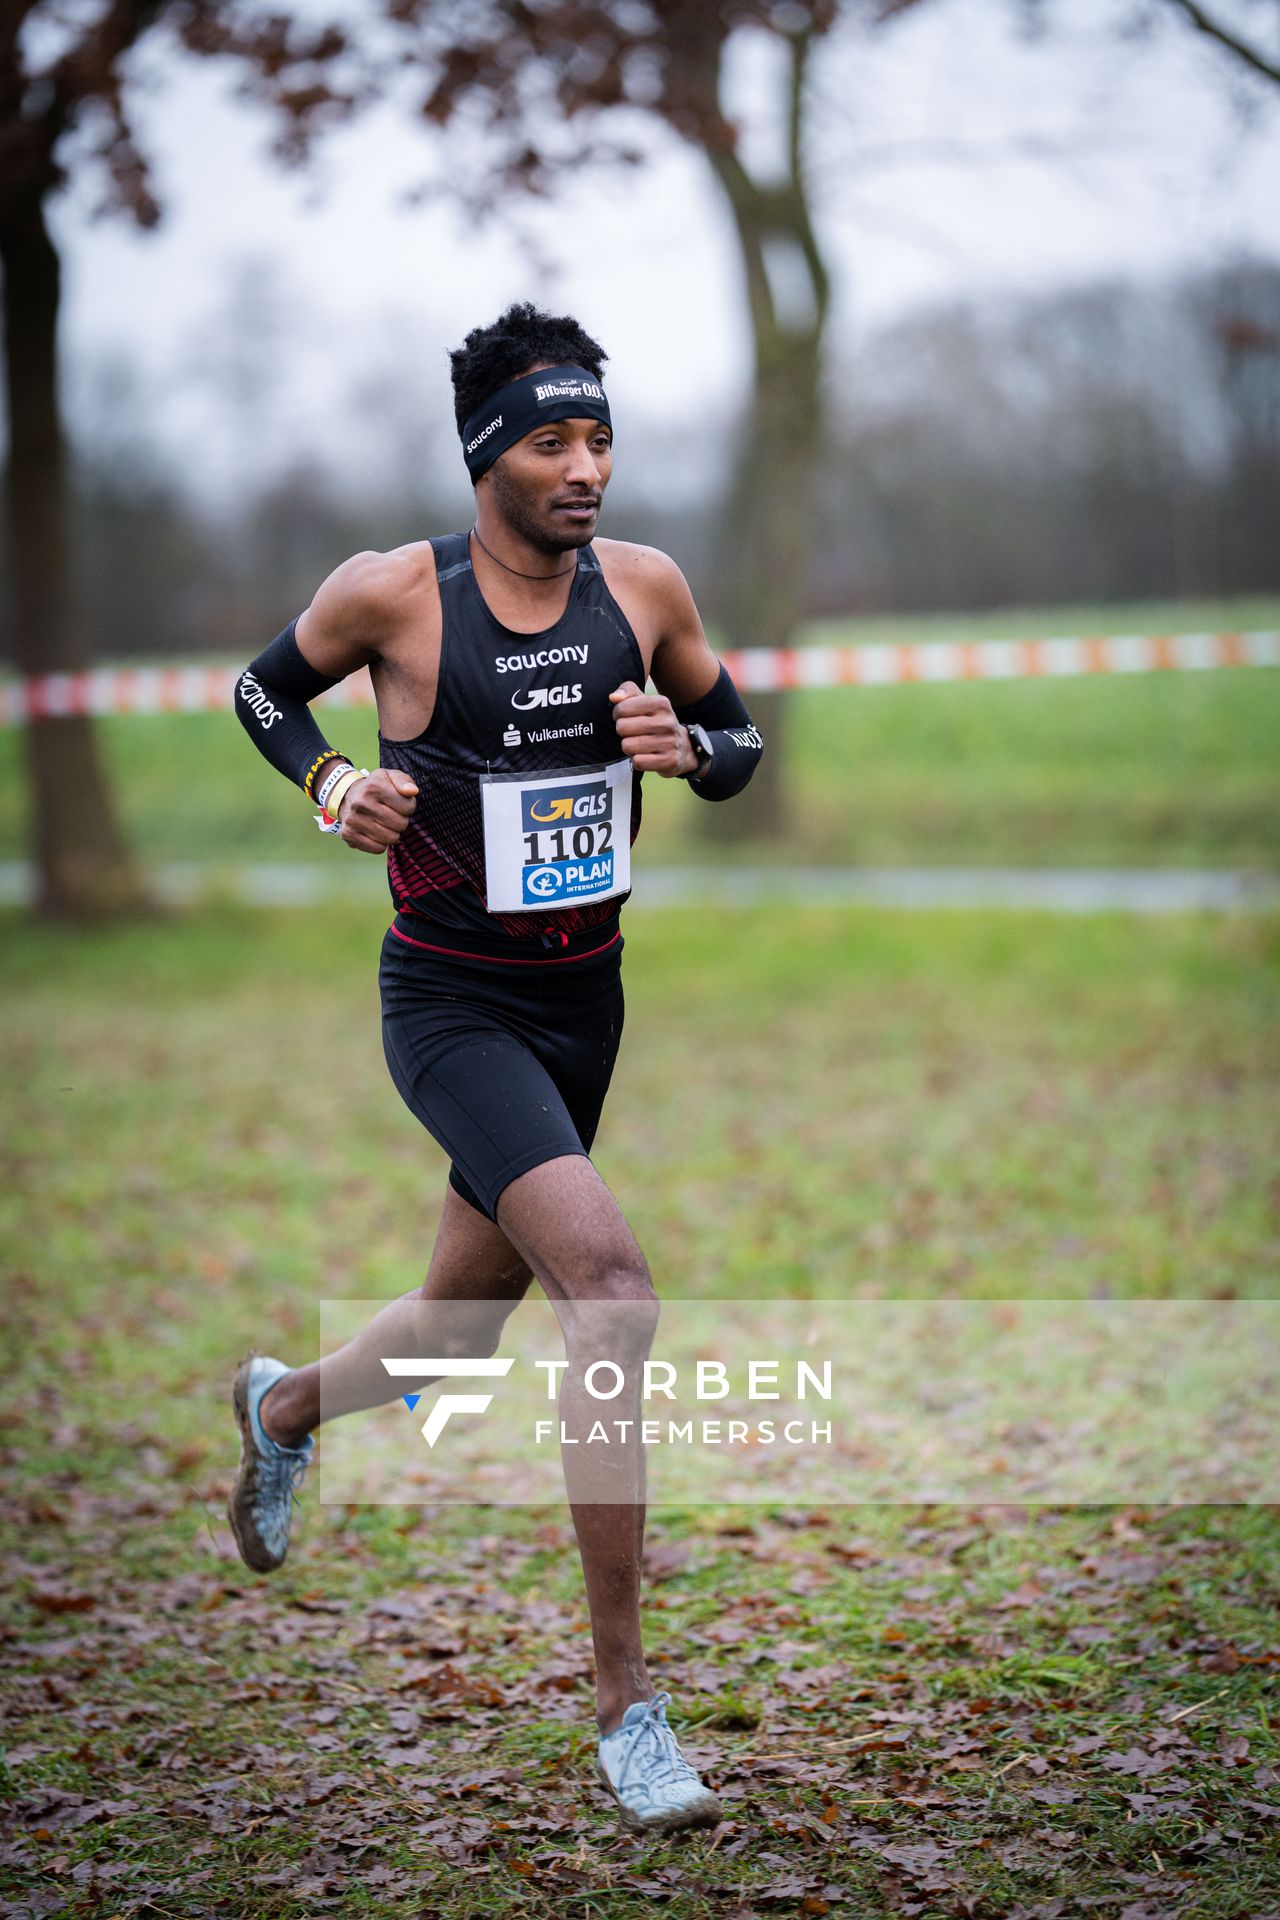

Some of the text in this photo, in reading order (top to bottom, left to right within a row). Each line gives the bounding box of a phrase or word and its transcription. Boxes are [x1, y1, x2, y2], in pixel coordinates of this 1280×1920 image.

[467, 415, 503, 454] saucony
[495, 644, 589, 674] saucony
[548, 683, 583, 706] GLS
[527, 722, 594, 743] Vulkaneifel
[573, 792, 607, 818] GLS
[523, 821, 613, 865] 1102
[565, 858, 612, 884] PLAN
[566, 878, 611, 893] INTERNATIONAL
